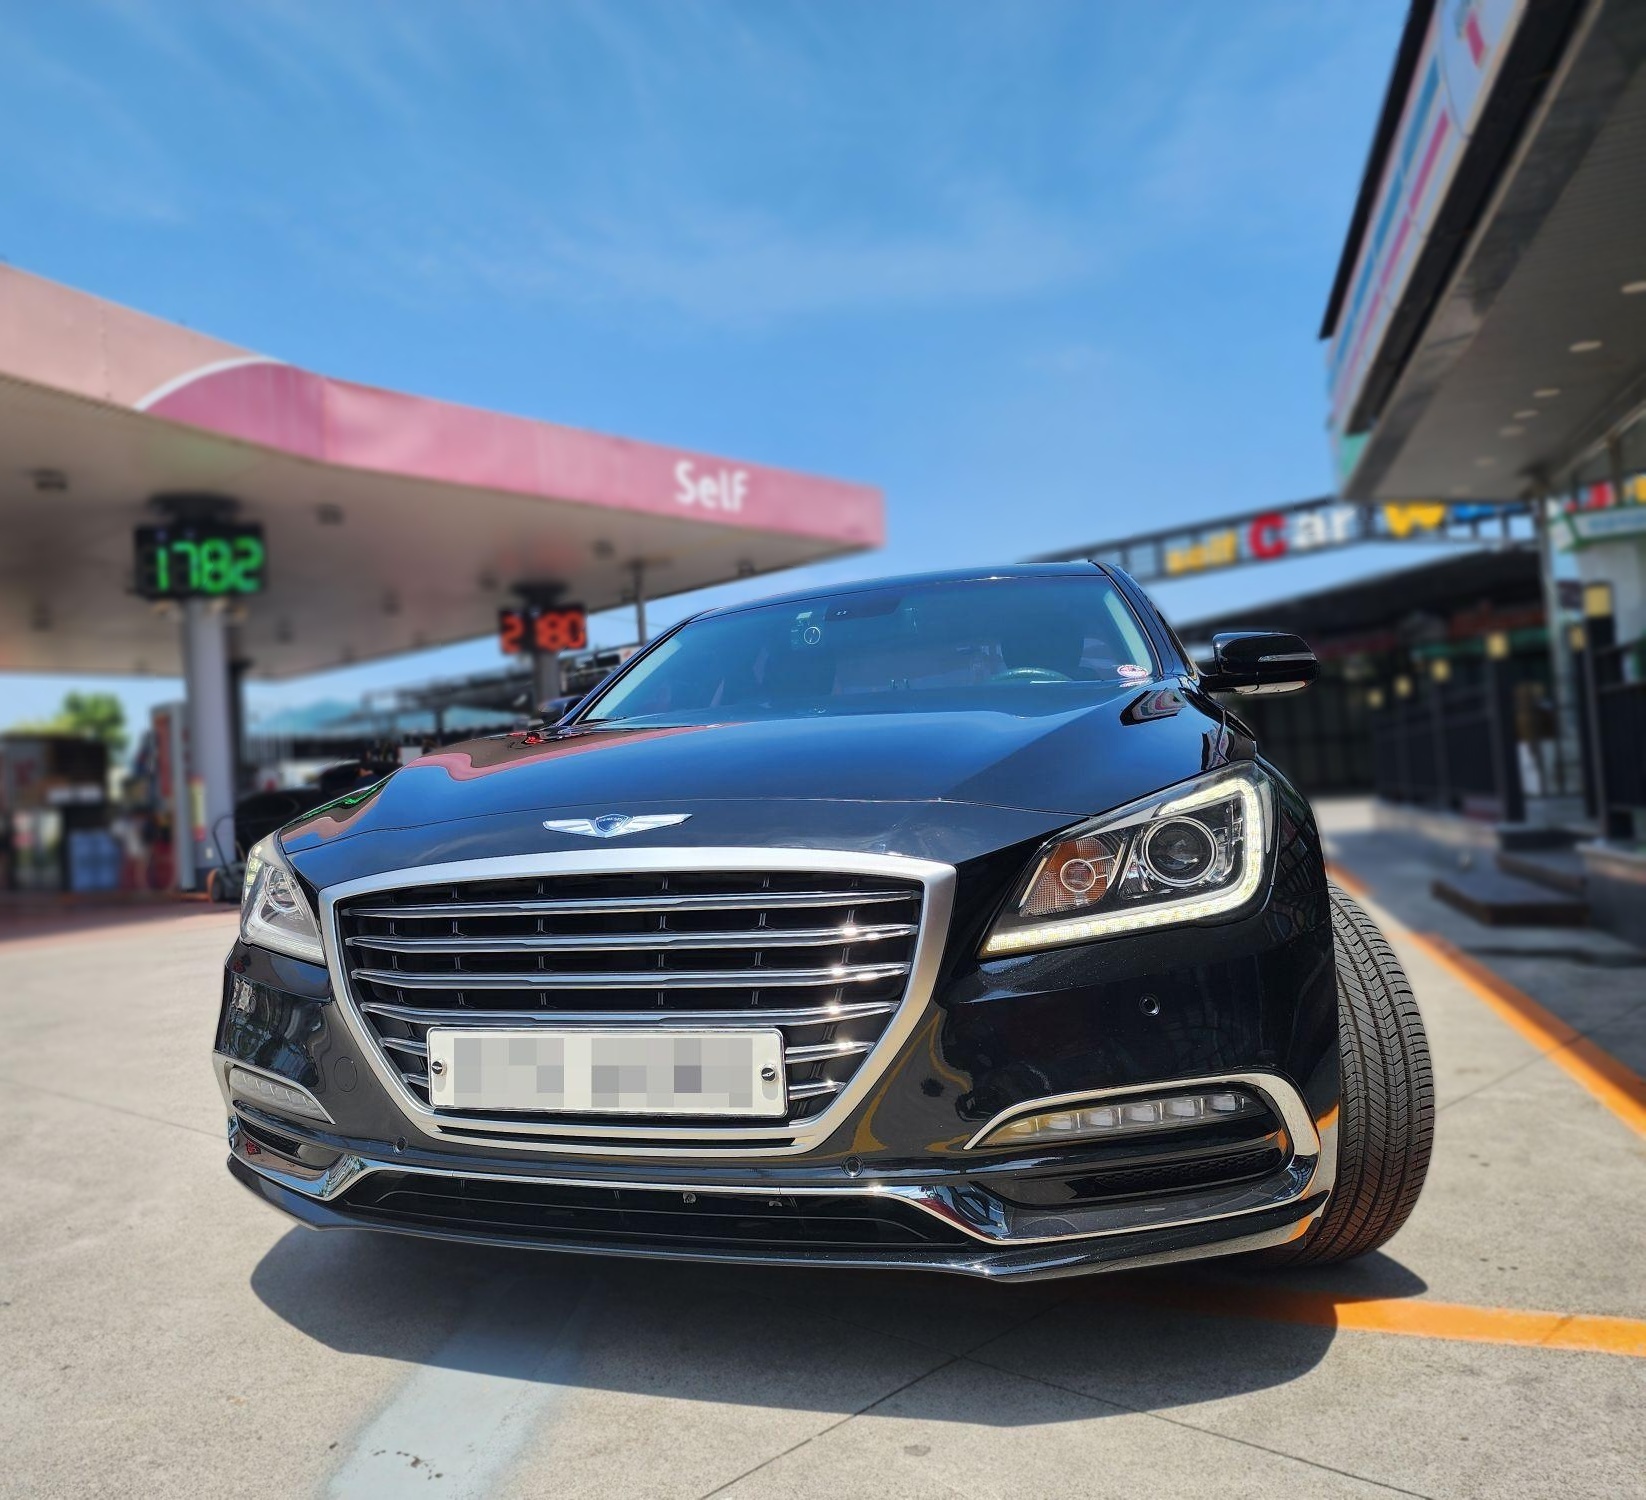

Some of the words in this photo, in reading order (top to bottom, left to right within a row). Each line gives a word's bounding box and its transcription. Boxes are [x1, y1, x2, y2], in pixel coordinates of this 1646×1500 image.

[673, 459, 748, 512] Self
[1248, 506, 1357, 561] Car
[157, 538, 263, 593] 1782
